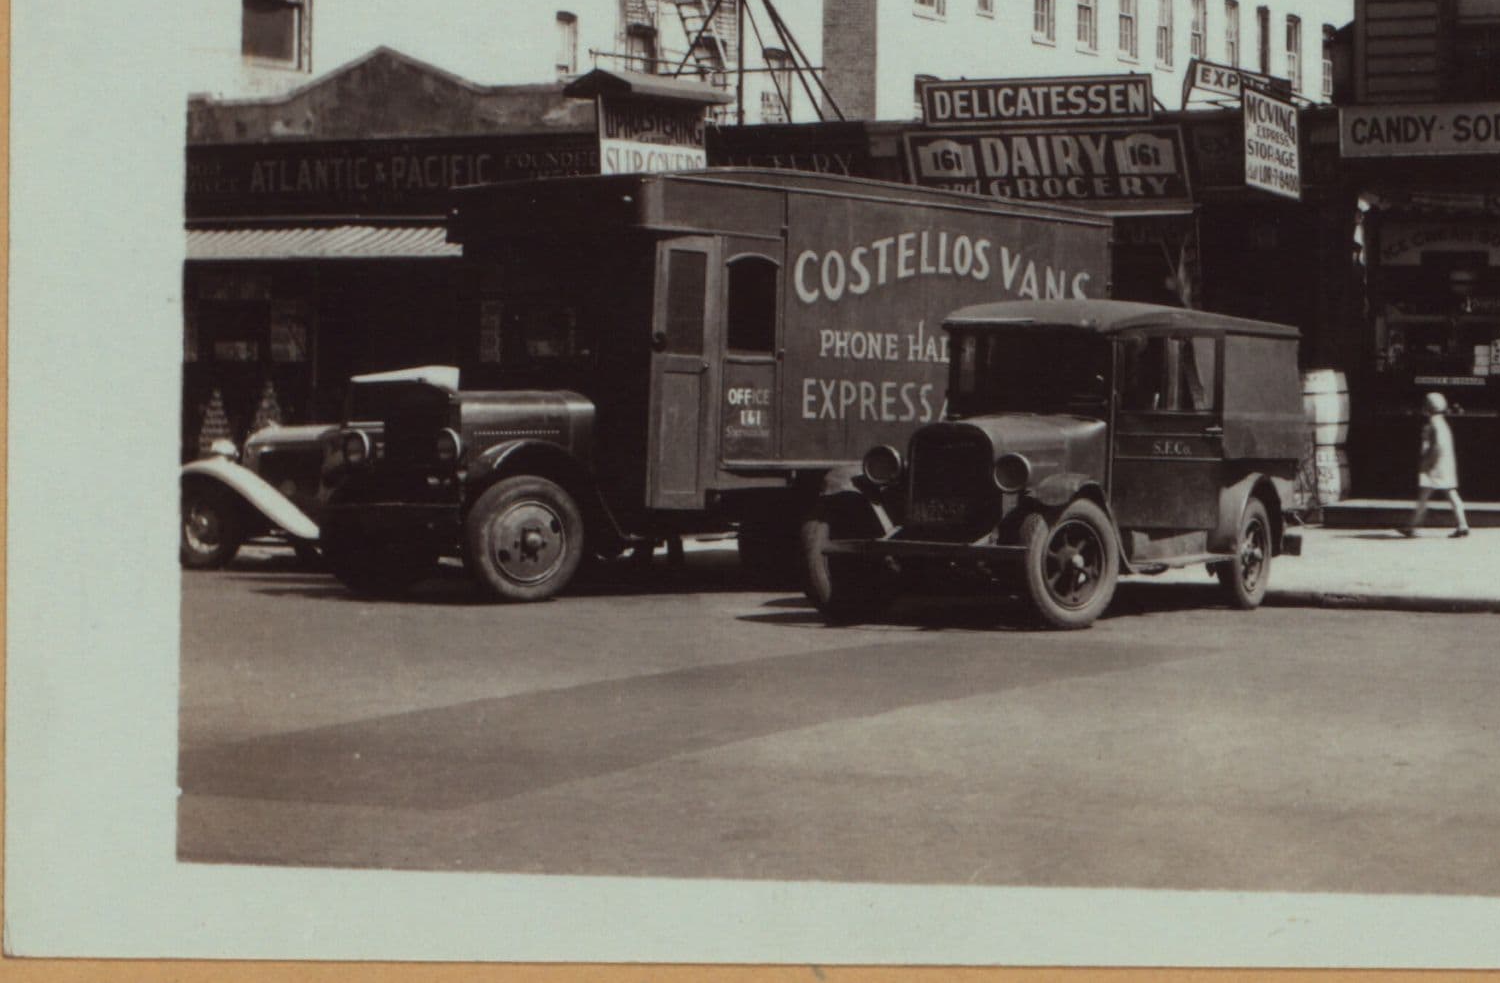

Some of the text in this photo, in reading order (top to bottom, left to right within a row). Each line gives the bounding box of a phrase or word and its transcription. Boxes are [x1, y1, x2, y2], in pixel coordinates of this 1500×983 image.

[933, 83, 1145, 120] DELICATESSEN
[1246, 95, 1296, 145] MOVING
[1350, 115, 1437, 145] CANDY
[932, 133, 1161, 178] 161 DAIRY 161
[1246, 139, 1297, 169] STORAGE
[249, 156, 369, 193] ATLANTIC
[391, 153, 492, 189] PACIFIC
[989, 176, 1169, 200] GROCERY
[794, 230, 1091, 304] COSTELLOS VANS
[819, 329, 899, 362] PHONE
[728, 387, 770, 406] OFFICE
[801, 377, 934, 424] EXPRESS
